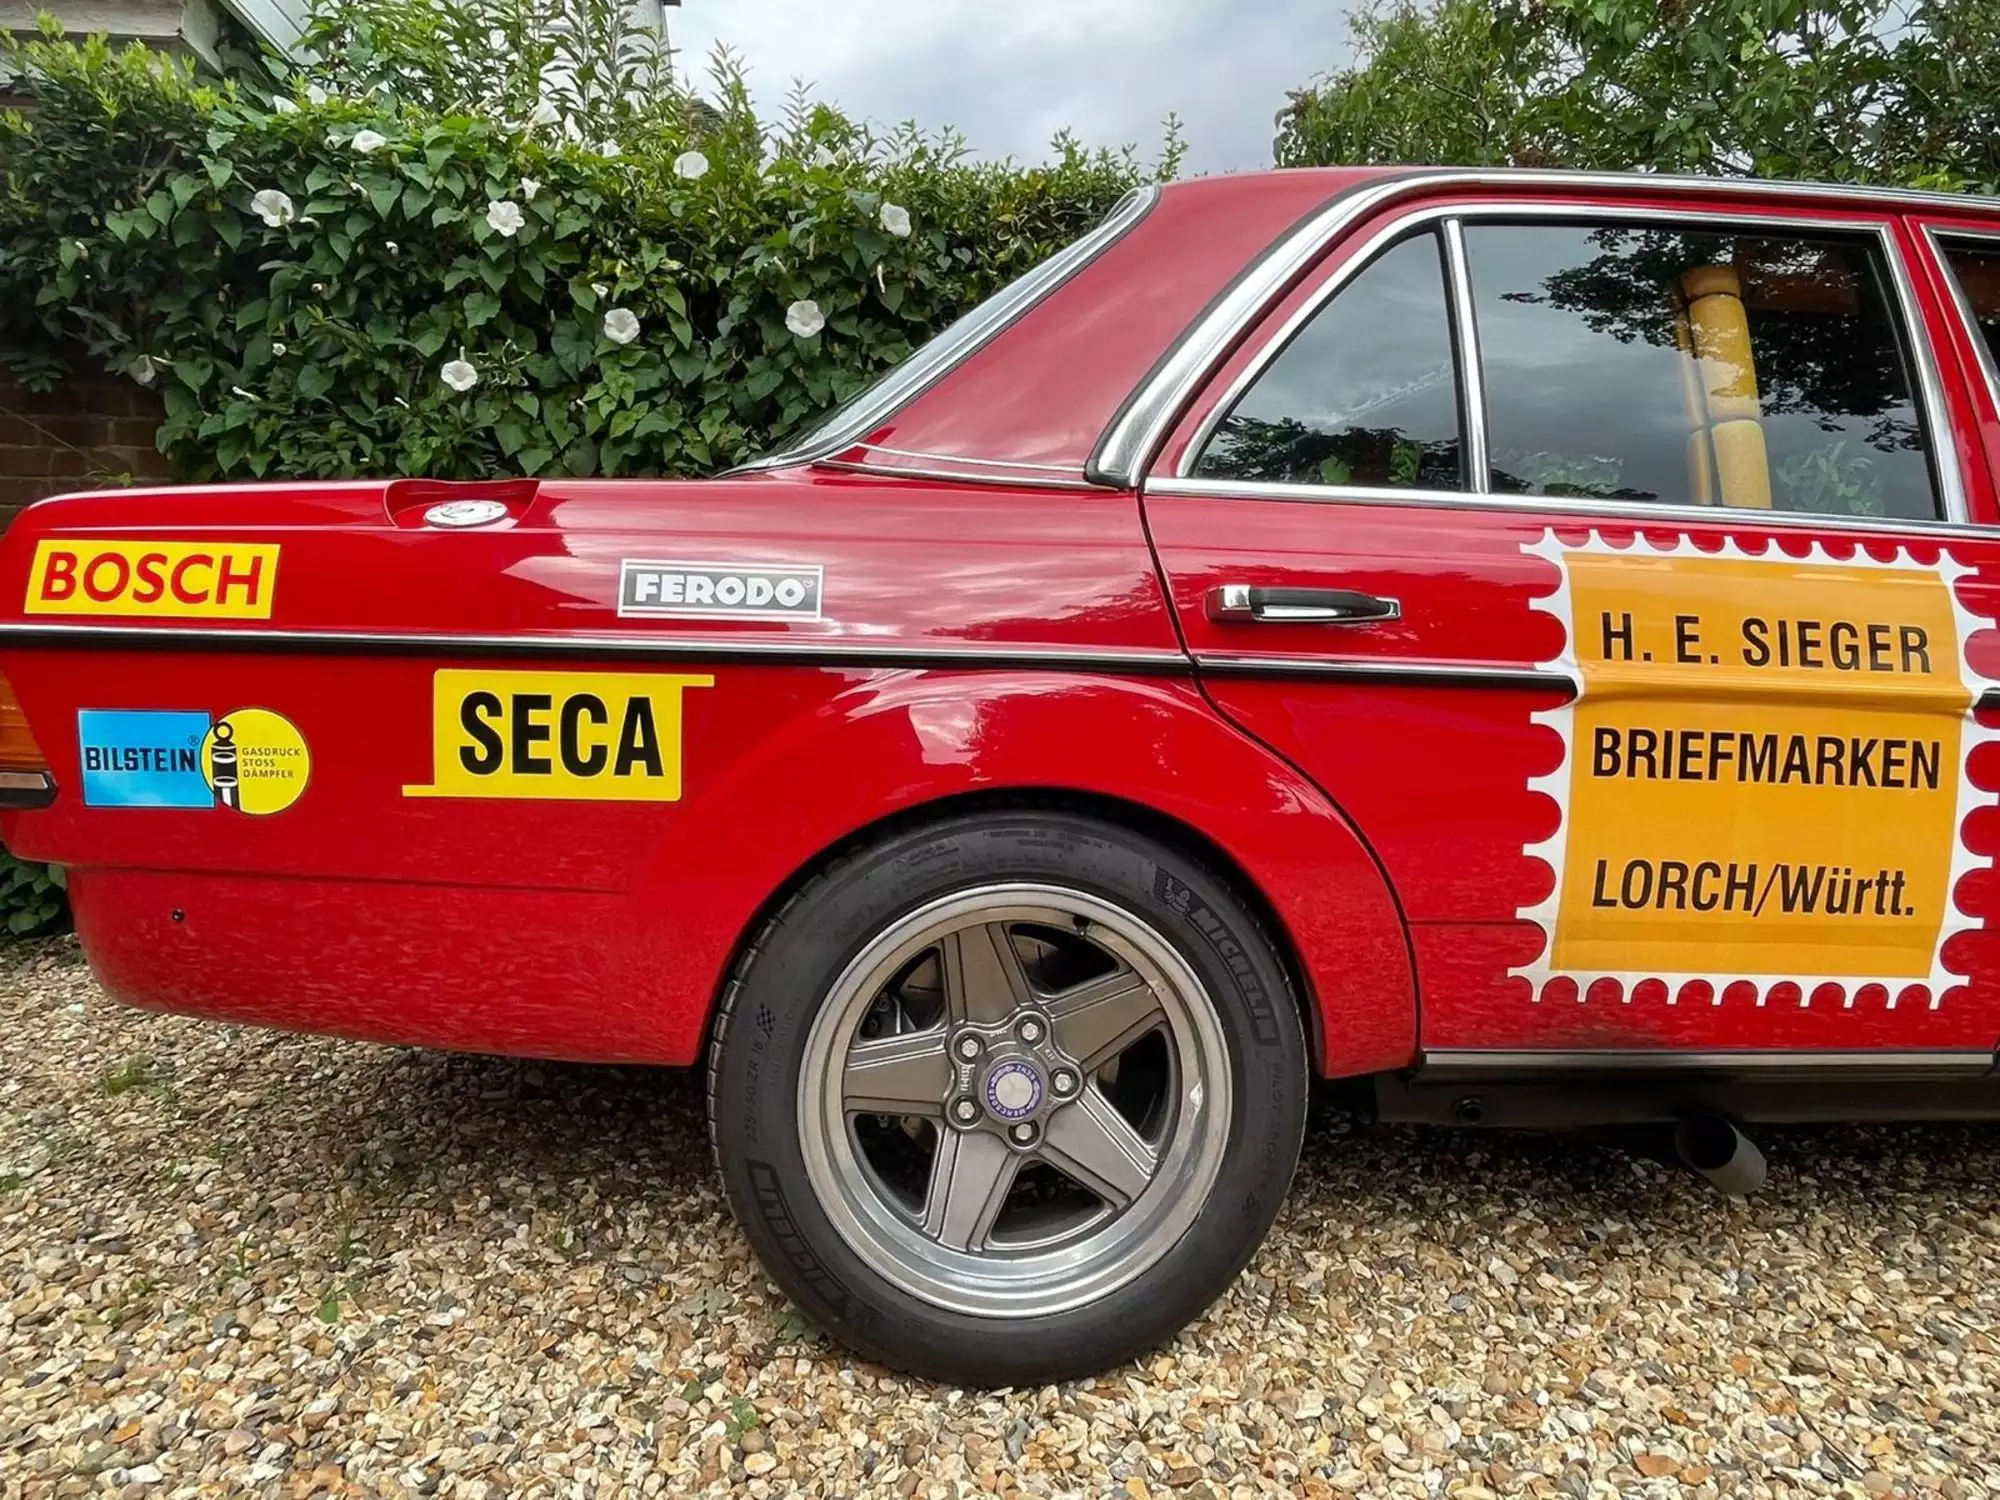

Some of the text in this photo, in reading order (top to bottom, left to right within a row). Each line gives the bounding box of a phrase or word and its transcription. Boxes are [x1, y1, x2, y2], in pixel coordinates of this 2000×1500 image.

[40, 551, 264, 606] BOSCH
[635, 573, 806, 607] FERODO
[1601, 611, 1932, 673] H. E. SIEGER
[85, 746, 196, 773] BILSTEIN
[241, 747, 301, 757] GASDRUCK
[459, 690, 665, 778] SECA
[1592, 727, 1941, 790] BRIEFMARKEN
[242, 758, 276, 767] STOSS
[242, 767, 295, 779] DÄMPFER
[1592, 858, 1914, 917] LORCH/Württ.
[1189, 907, 1277, 1040] MICHELIN
